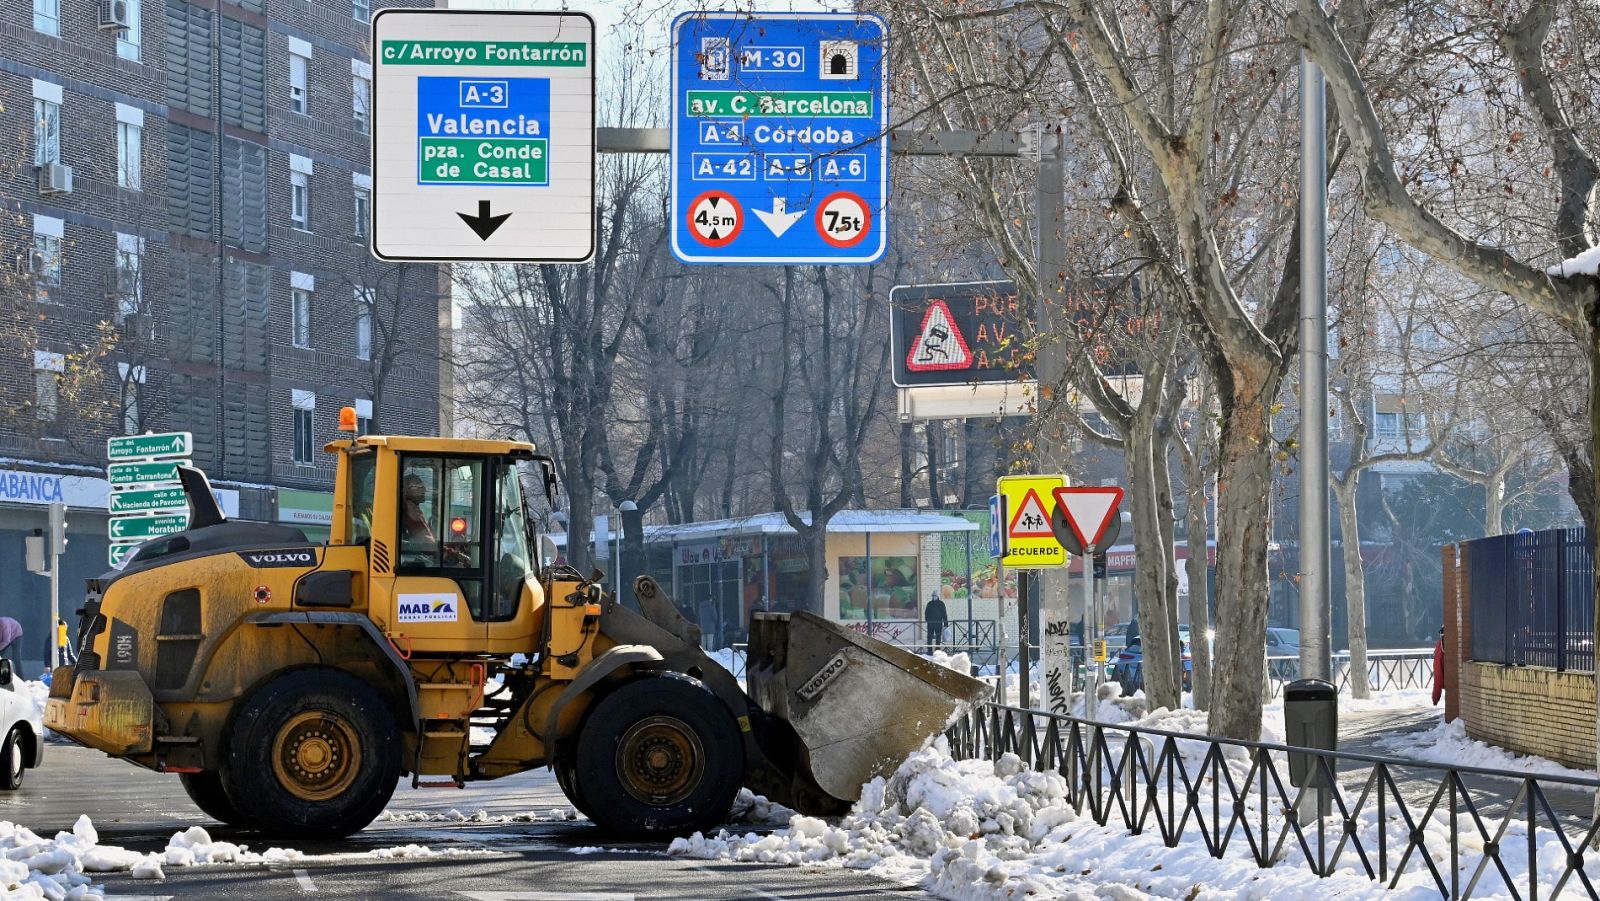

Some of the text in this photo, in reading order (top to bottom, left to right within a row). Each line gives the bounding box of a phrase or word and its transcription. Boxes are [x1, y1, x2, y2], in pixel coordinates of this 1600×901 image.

[384, 44, 584, 62] c/Arroyo Fontarrón
[744, 51, 801, 68] M-30
[465, 86, 504, 103] A-3
[691, 95, 868, 114] av. C. Barcelona
[427, 113, 540, 135] Valencia
[704, 125, 854, 144] A-4 Córdoba
[424, 143, 543, 161] pza. Conde
[436, 162, 531, 178] de Casal
[698, 158, 862, 176] A-42 A-5 A-6
[110, 444, 170, 456] Arroyo Fontarrón
[0, 473, 63, 502] ABANCA
[122, 500, 151, 509] Hacienda
[160, 498, 185, 507] Pavones
[155, 517, 176, 525] avenida
[247, 553, 311, 563] VOLVO
[1107, 554, 1137, 567] MAPFR
[399, 603, 430, 614] MAB
[803, 658, 844, 695] VOLVO
